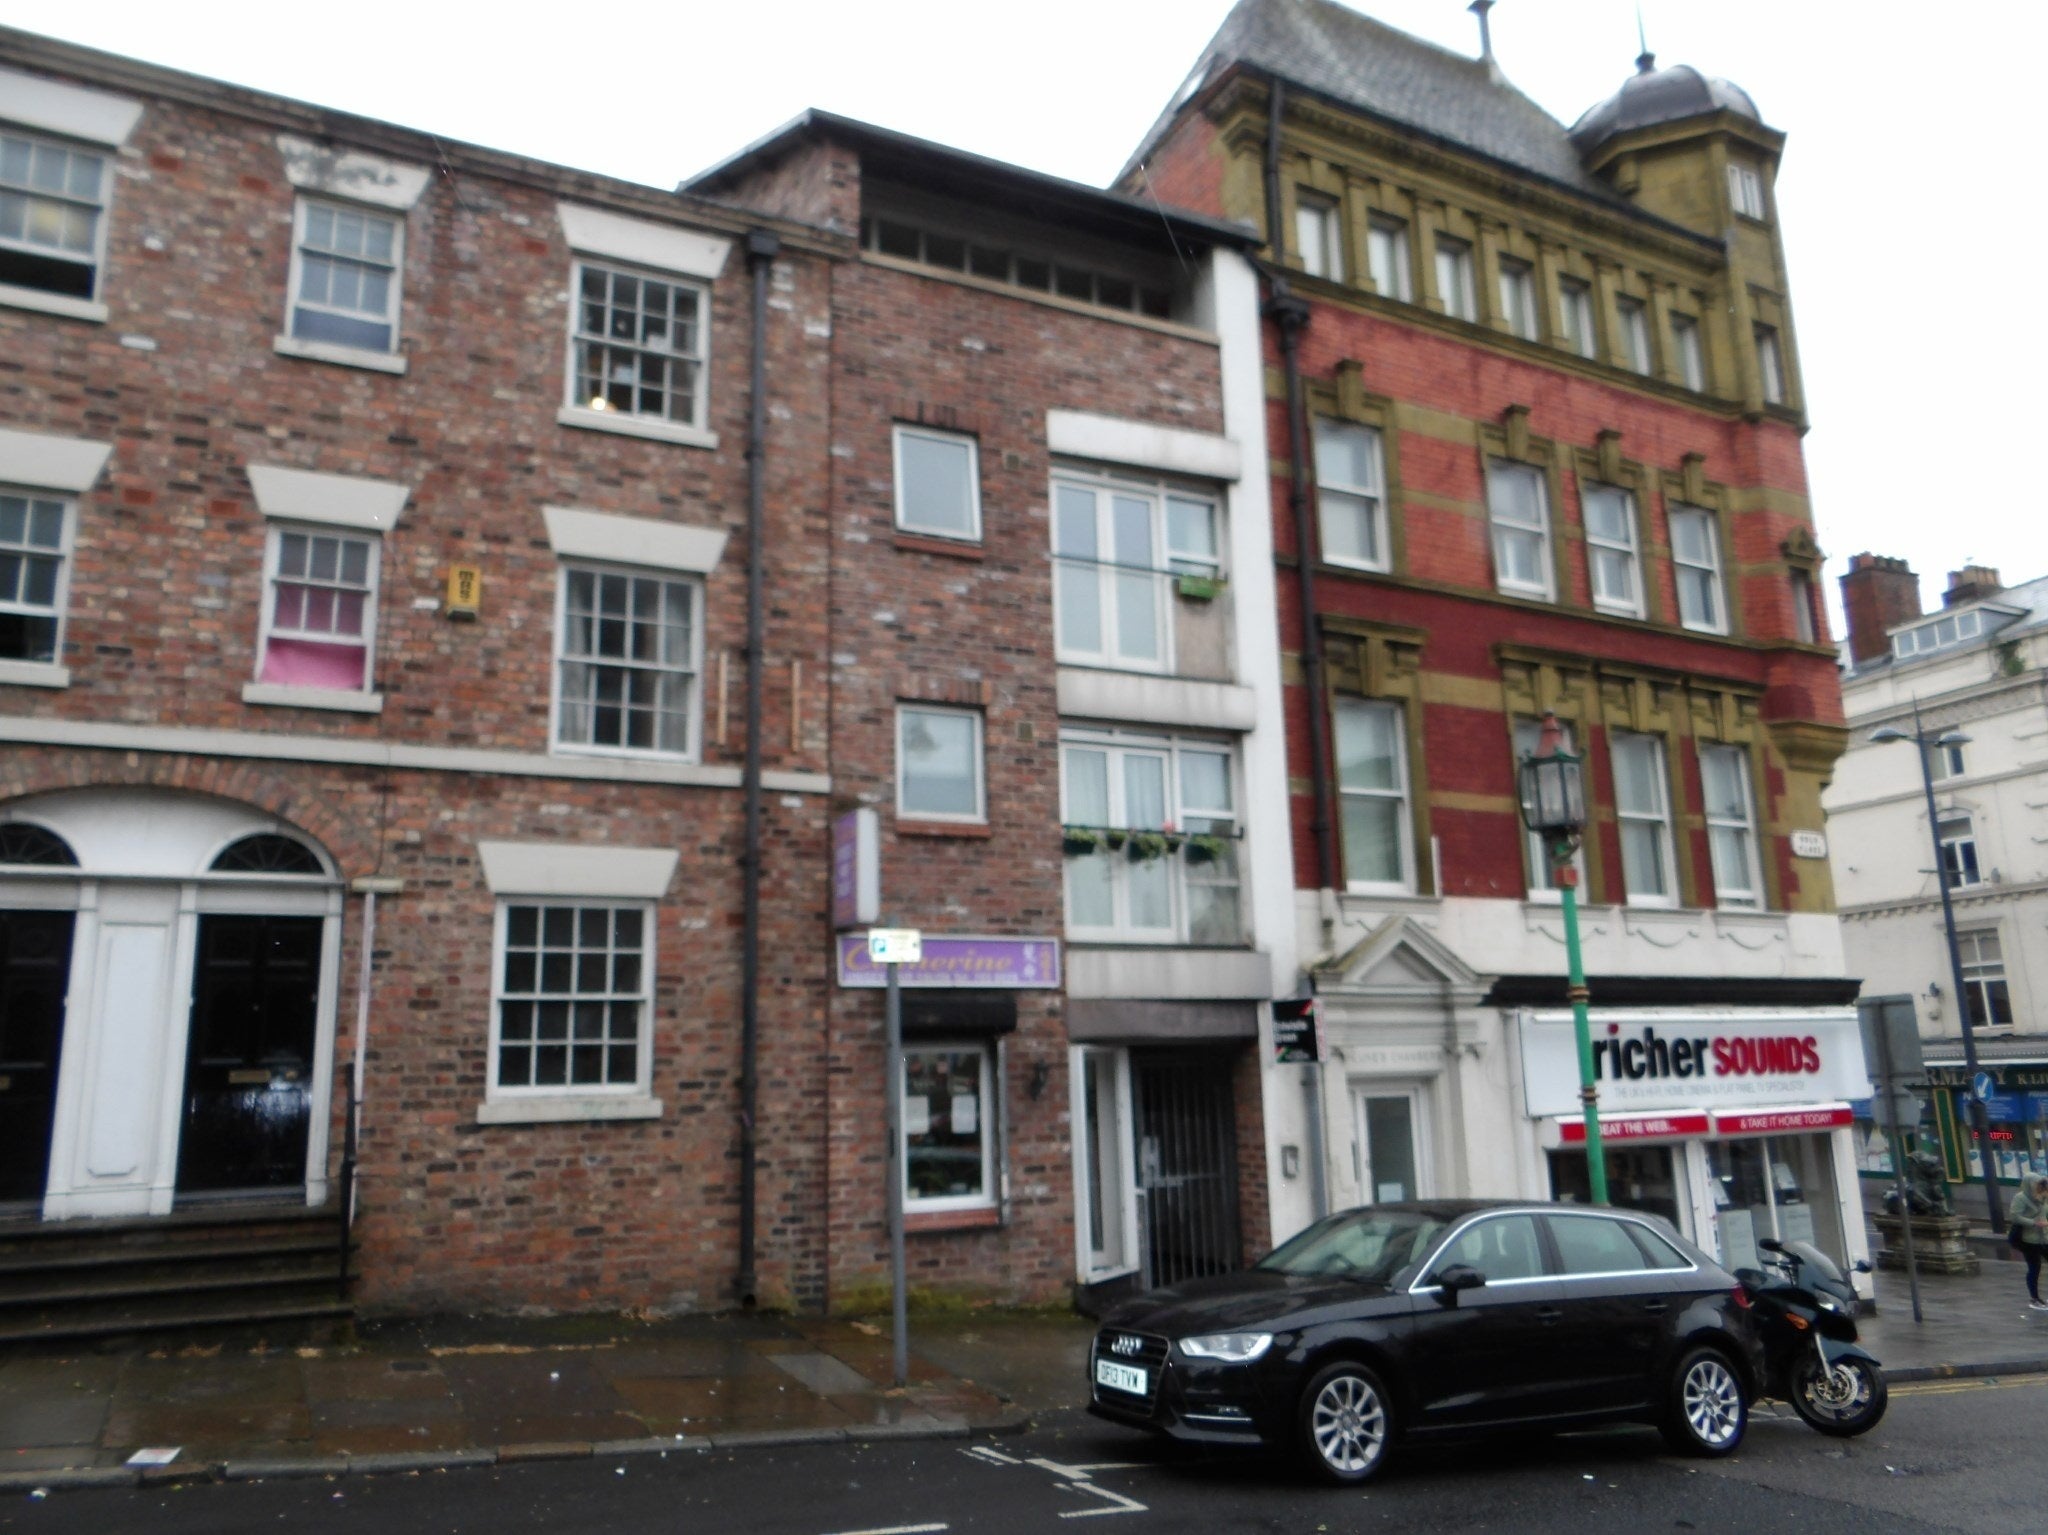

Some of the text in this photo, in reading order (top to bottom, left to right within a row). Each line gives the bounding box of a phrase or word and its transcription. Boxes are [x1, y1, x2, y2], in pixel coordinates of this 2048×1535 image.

[1593, 1022, 1820, 1080] richer SOUNDS
[1600, 1122, 1621, 1136] EAT
[1622, 1121, 1643, 1135] THE
[1748, 1117, 1768, 1129] TAKE
[1770, 1117, 1777, 1127] IT
[1779, 1115, 1803, 1127] HOME
[1804, 1113, 1832, 1125] TODAY!
